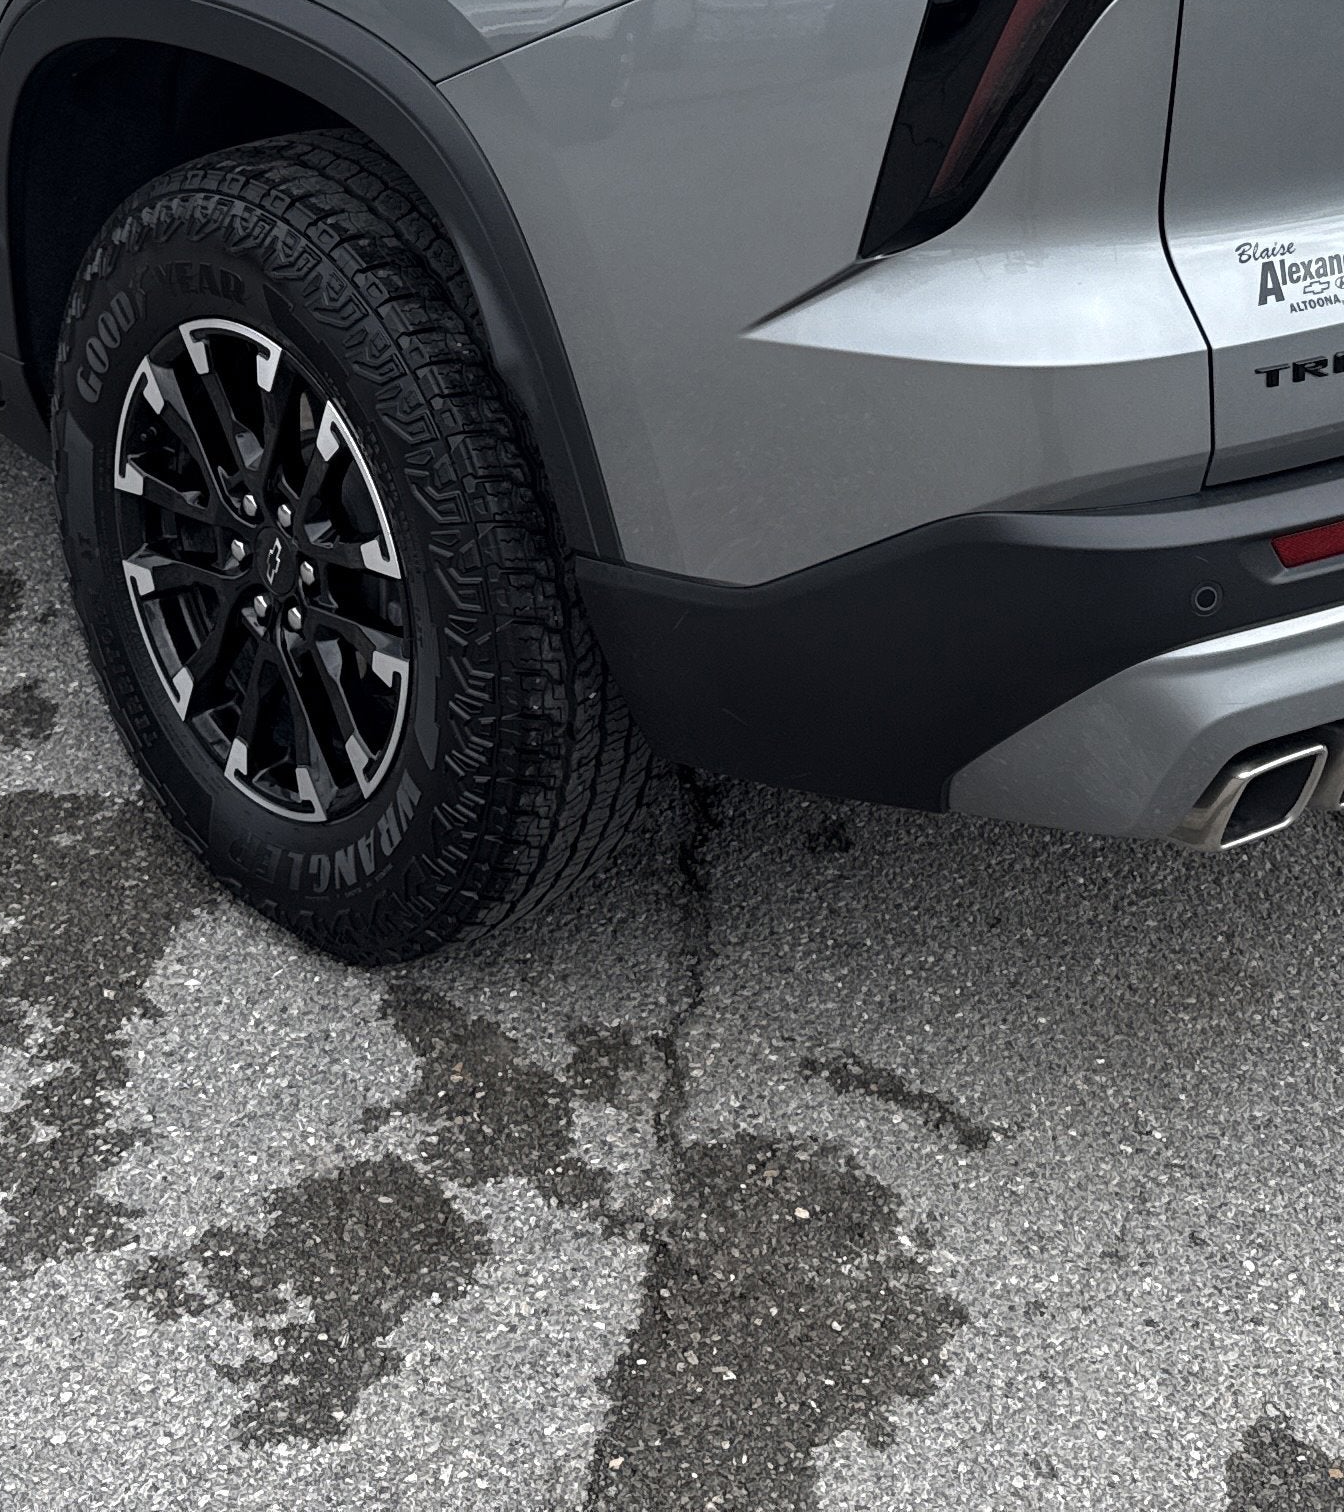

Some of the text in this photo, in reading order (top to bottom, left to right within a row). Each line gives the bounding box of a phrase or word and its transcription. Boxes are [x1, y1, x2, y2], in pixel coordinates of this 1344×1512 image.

[1235, 241, 1296, 264] Blaise
[76, 260, 246, 404] GOODYEAR
[1290, 294, 1344, 313] ALTOONA,
[228, 767, 423, 893] WRANGLER
